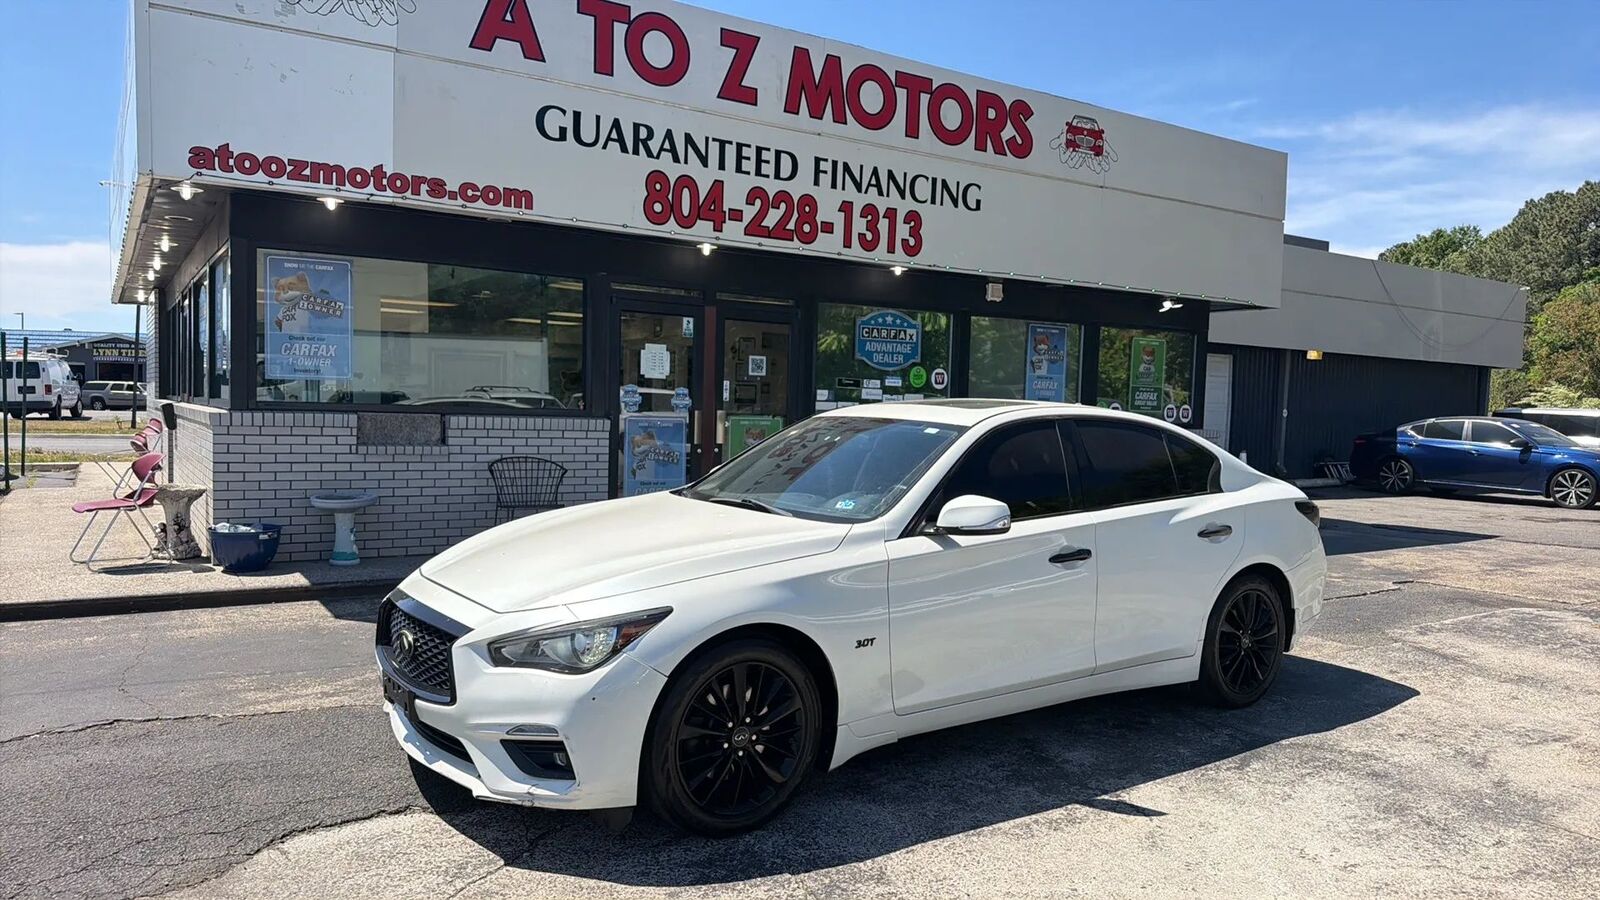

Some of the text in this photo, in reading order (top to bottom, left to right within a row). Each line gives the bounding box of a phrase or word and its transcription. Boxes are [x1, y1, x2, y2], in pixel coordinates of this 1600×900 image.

[469, 0, 1035, 159] A TO Z MOTORS
[535, 104, 983, 213] GUARANTEED FINANCING
[187, 142, 534, 211] atoozmotors.com
[642, 169, 924, 257] 804-228-1313
[862, 328, 916, 341] CARFAX
[281, 342, 337, 357] CARFAX
[865, 342, 912, 353] ADVANTAGE
[288, 358, 331, 367] 1-OWNER
[873, 354, 904, 364] DEALER
[1032, 380, 1058, 390] CARFAX
[1135, 391, 1158, 400] CARFAX
